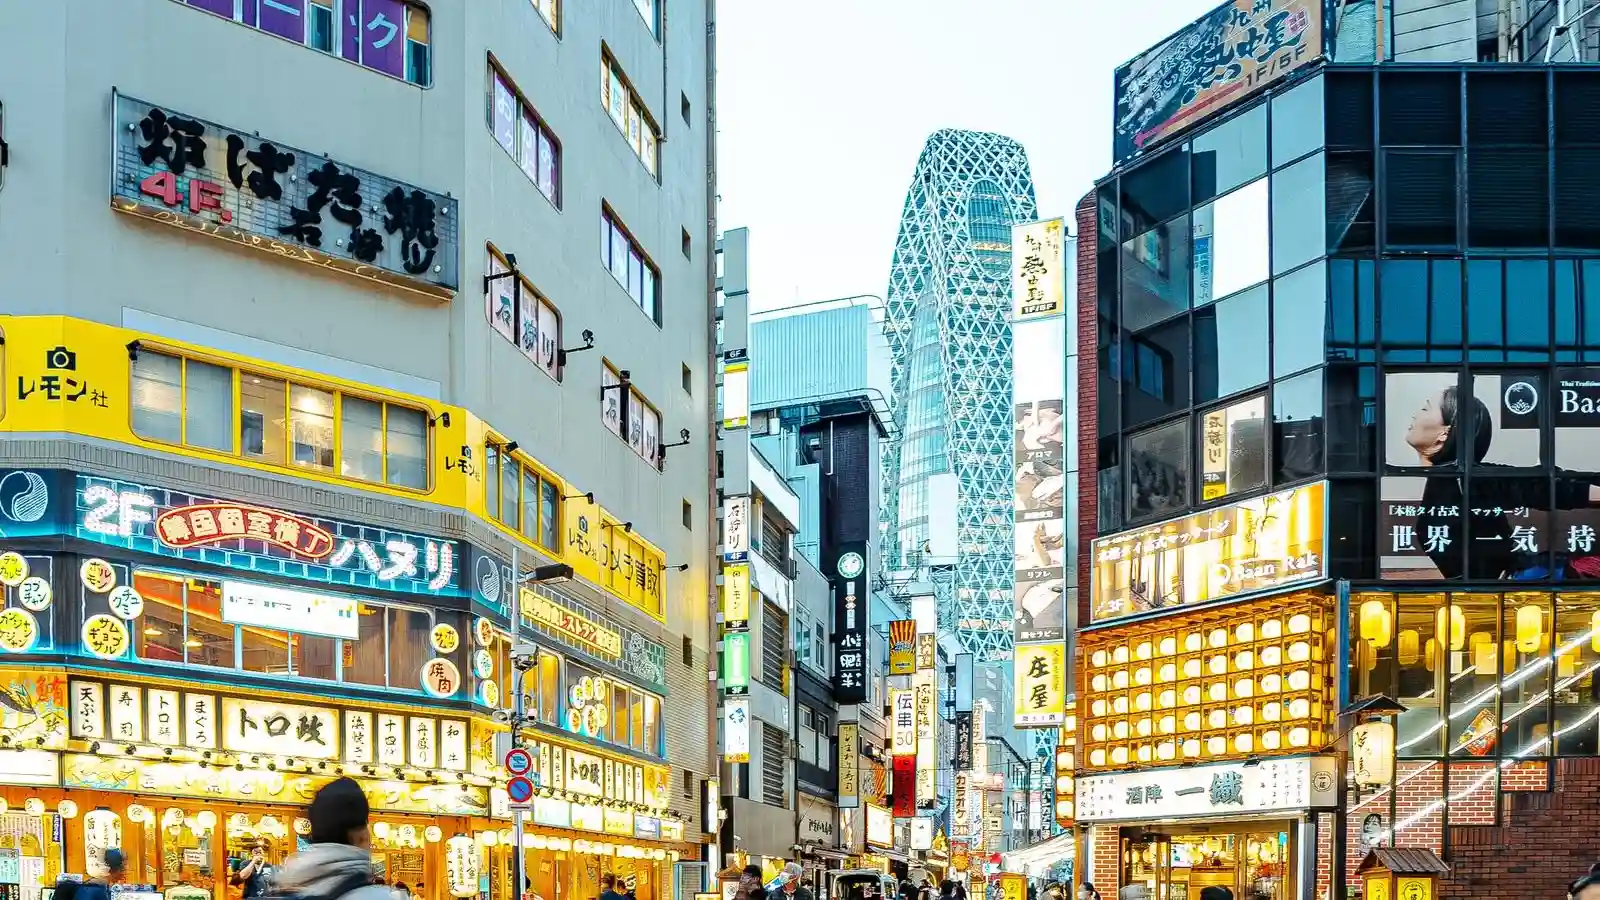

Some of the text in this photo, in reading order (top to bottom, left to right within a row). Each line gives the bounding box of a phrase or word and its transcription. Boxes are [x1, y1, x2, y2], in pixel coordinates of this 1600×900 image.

[1246, 42, 1308, 87] 1F/5F
[730, 350, 741, 358] 6F
[83, 485, 155, 537] 2F
[329, 536, 455, 591] ハヌリ
[1026, 655, 1051, 710] 庄屋
[80, 687, 95, 734] 天ぷら
[118, 691, 133, 737] 寿司
[194, 700, 208, 744] まぐろ
[239, 707, 327, 747] トロ政
[896, 693, 913, 729] 伝串
[446, 725, 460, 764] 和牛
[955, 776, 966, 819] カラオケ
